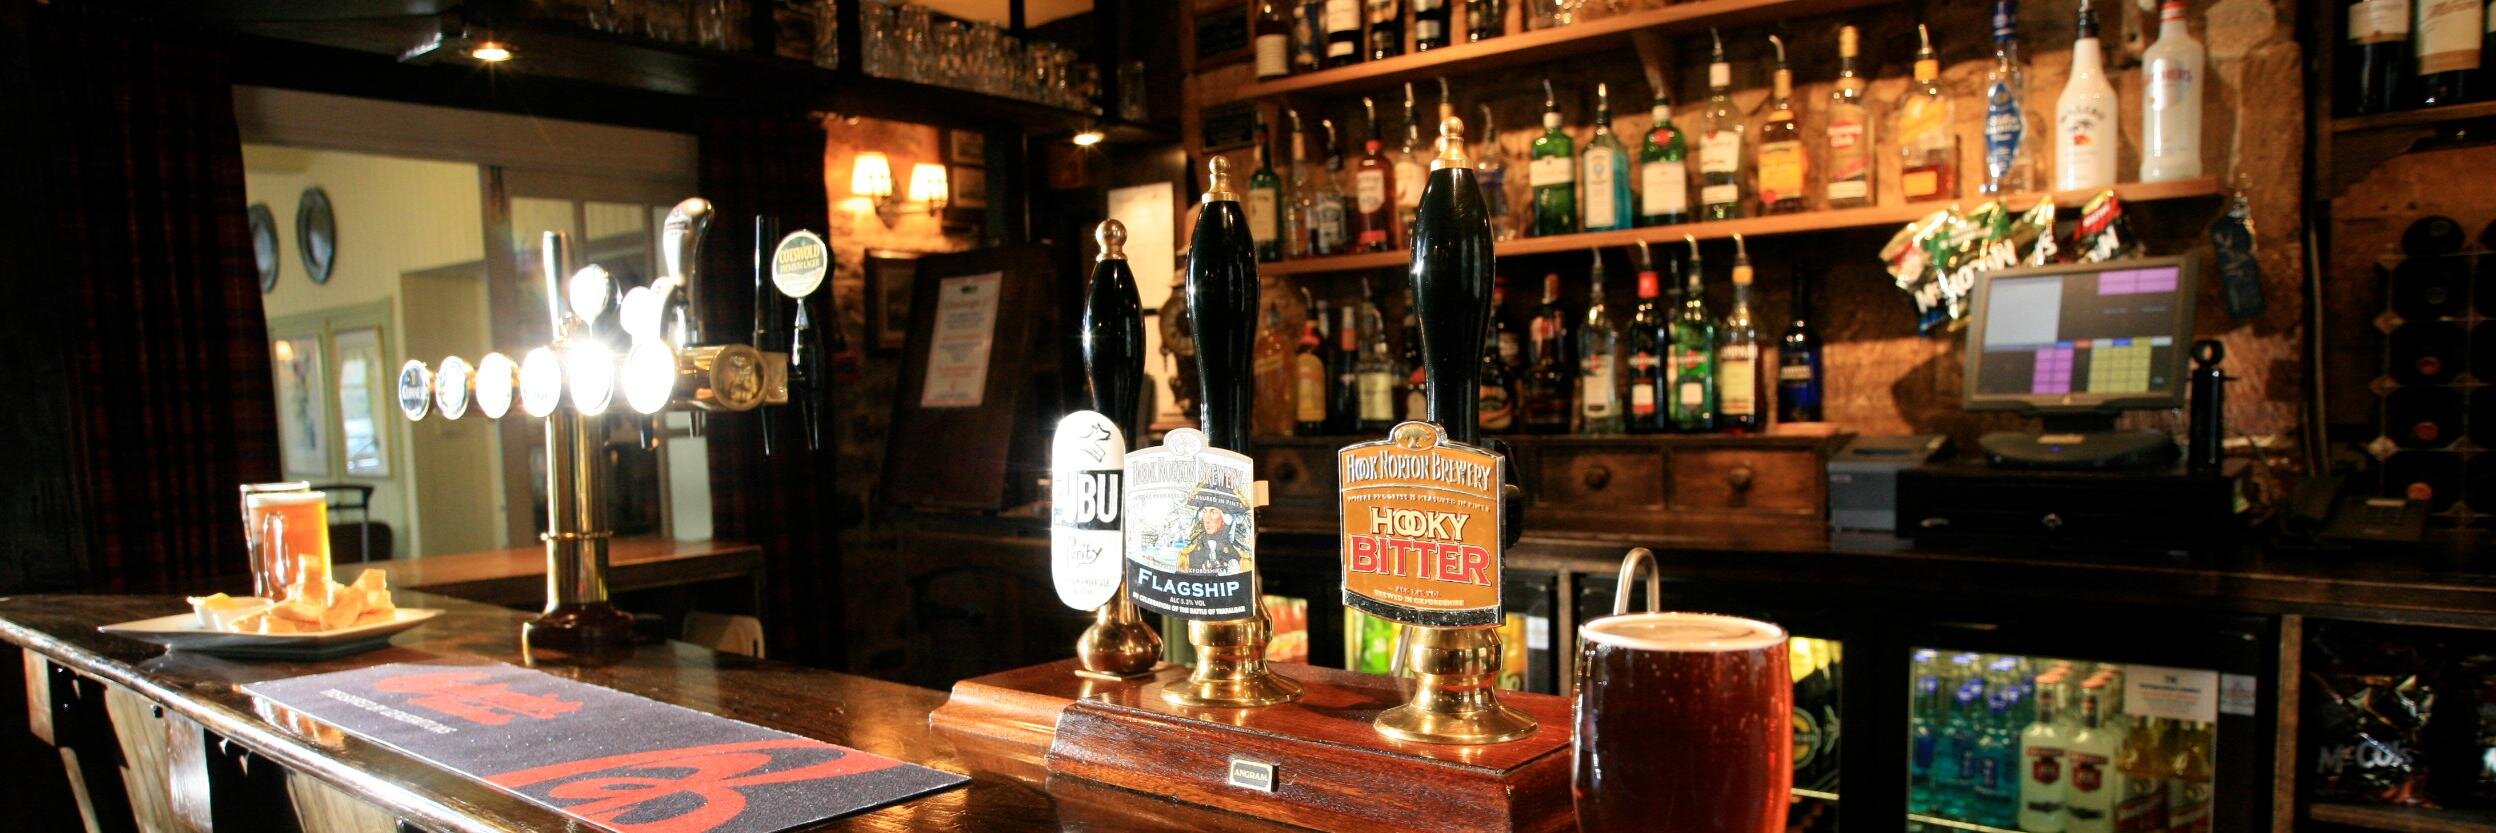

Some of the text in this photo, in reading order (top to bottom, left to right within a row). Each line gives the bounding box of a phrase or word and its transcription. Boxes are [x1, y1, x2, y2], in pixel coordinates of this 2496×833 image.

[779, 243, 820, 265] COTSWOLD
[1198, 456, 1243, 490] BREWERY
[1346, 450, 1491, 491] HOOK NORTON BREWERY
[1369, 506, 1470, 542] HOOKY
[1350, 534, 1492, 587] BITTER
[1138, 567, 1240, 598] FLAGSHIP
[1139, 594, 1171, 611] CELEBRATION
[1179, 606, 1189, 614] THE
[1190, 606, 1207, 615] BATTLE
[1208, 607, 1216, 615] OF
[1216, 605, 1246, 615] TRAFALGAR
[1195, 599, 1206, 607] VOL
[1413, 597, 1465, 606] OXFORDSHIRE
[1234, 768, 1268, 782] ANGRAM
